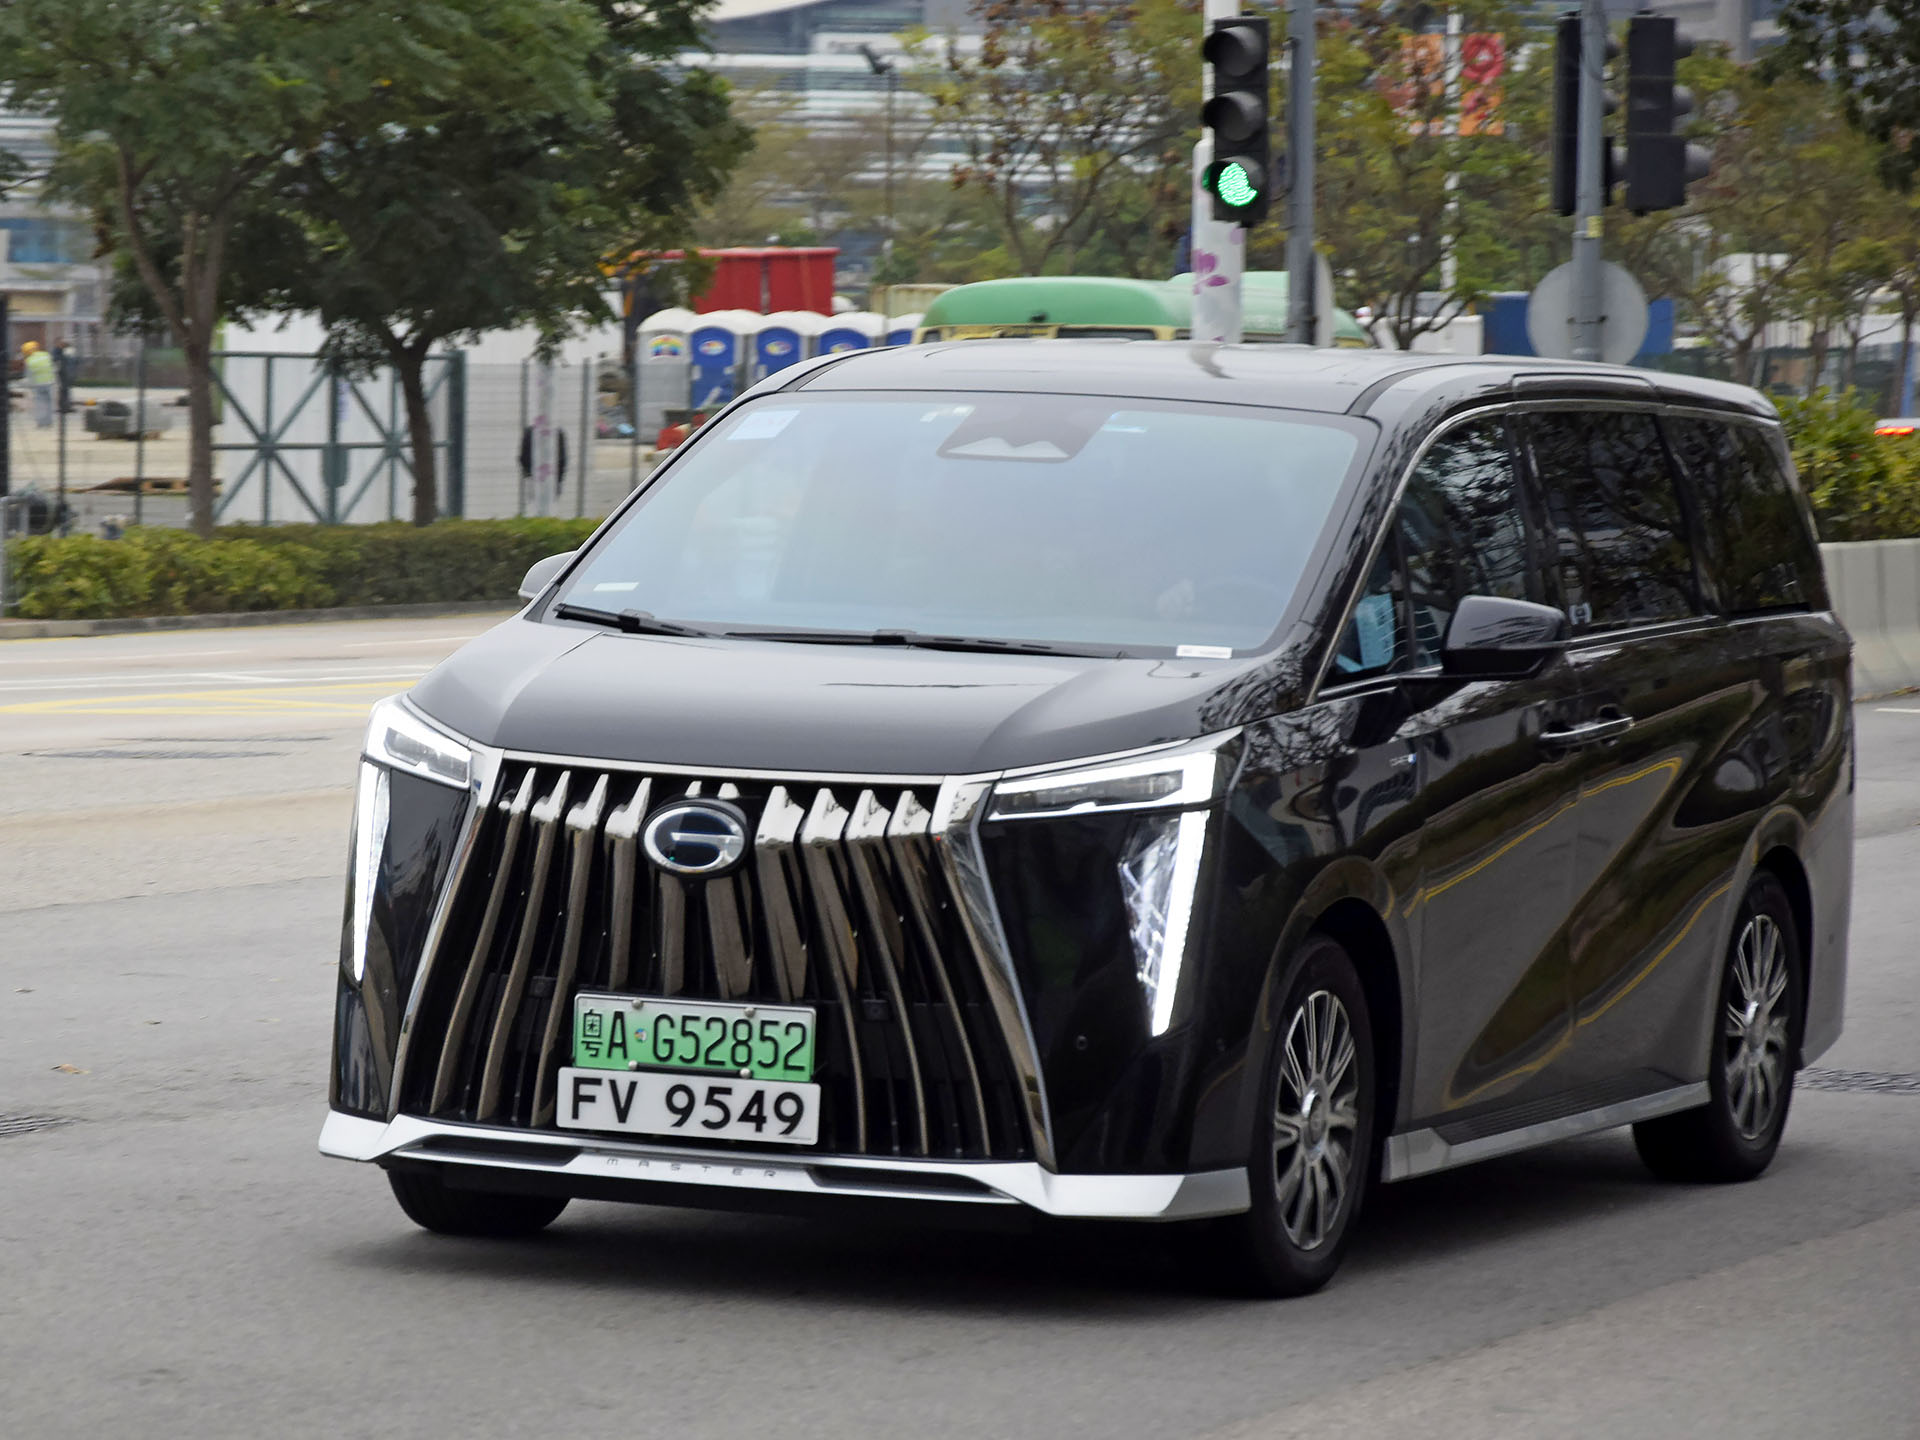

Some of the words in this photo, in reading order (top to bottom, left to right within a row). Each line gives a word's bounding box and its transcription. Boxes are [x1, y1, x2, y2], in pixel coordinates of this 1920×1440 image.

[652, 1014, 807, 1071] G52852
[571, 1076, 638, 1124] FV
[664, 1084, 804, 1135] 9549
[606, 1157, 776, 1177] MASTER
